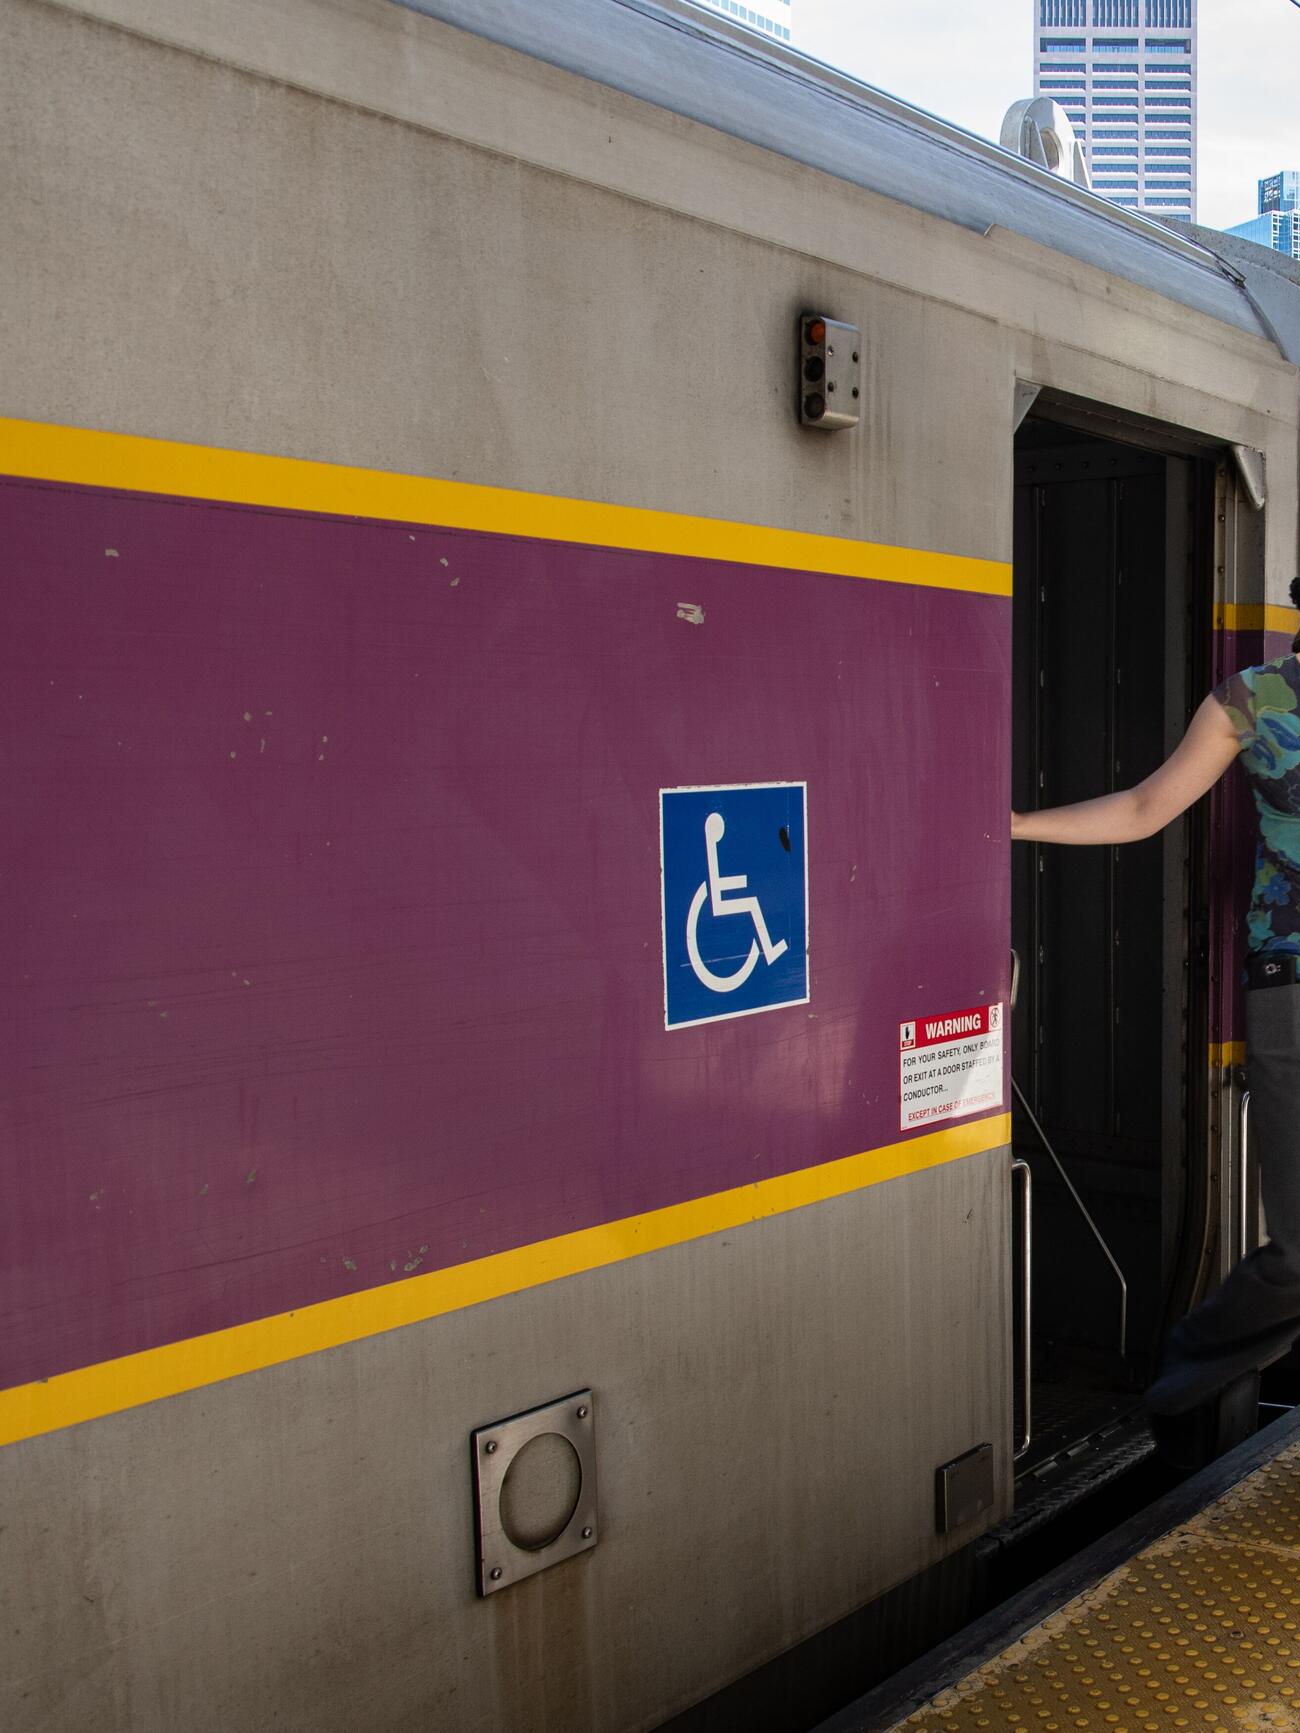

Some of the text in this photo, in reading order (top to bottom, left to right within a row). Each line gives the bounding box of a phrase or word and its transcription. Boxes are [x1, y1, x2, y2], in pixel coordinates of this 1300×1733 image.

[925, 1013, 981, 1039] WARNING
[903, 1057, 917, 1068] FOR
[918, 1053, 936, 1064] YOUR
[963, 1043, 978, 1054] ONLY
[903, 1075, 913, 1085] OR
[914, 1071, 928, 1082] EXIT
[928, 1069, 937, 1078] AT
[937, 1068, 942, 1076] A
[943, 1064, 961, 1075] DOOR
[961, 1057, 987, 1070] STAFFED
[908, 1107, 930, 1121] EXCEPT
[930, 1105, 938, 1115] IN
[938, 1102, 953, 1114] CASE
[953, 1099, 962, 1109] OF
